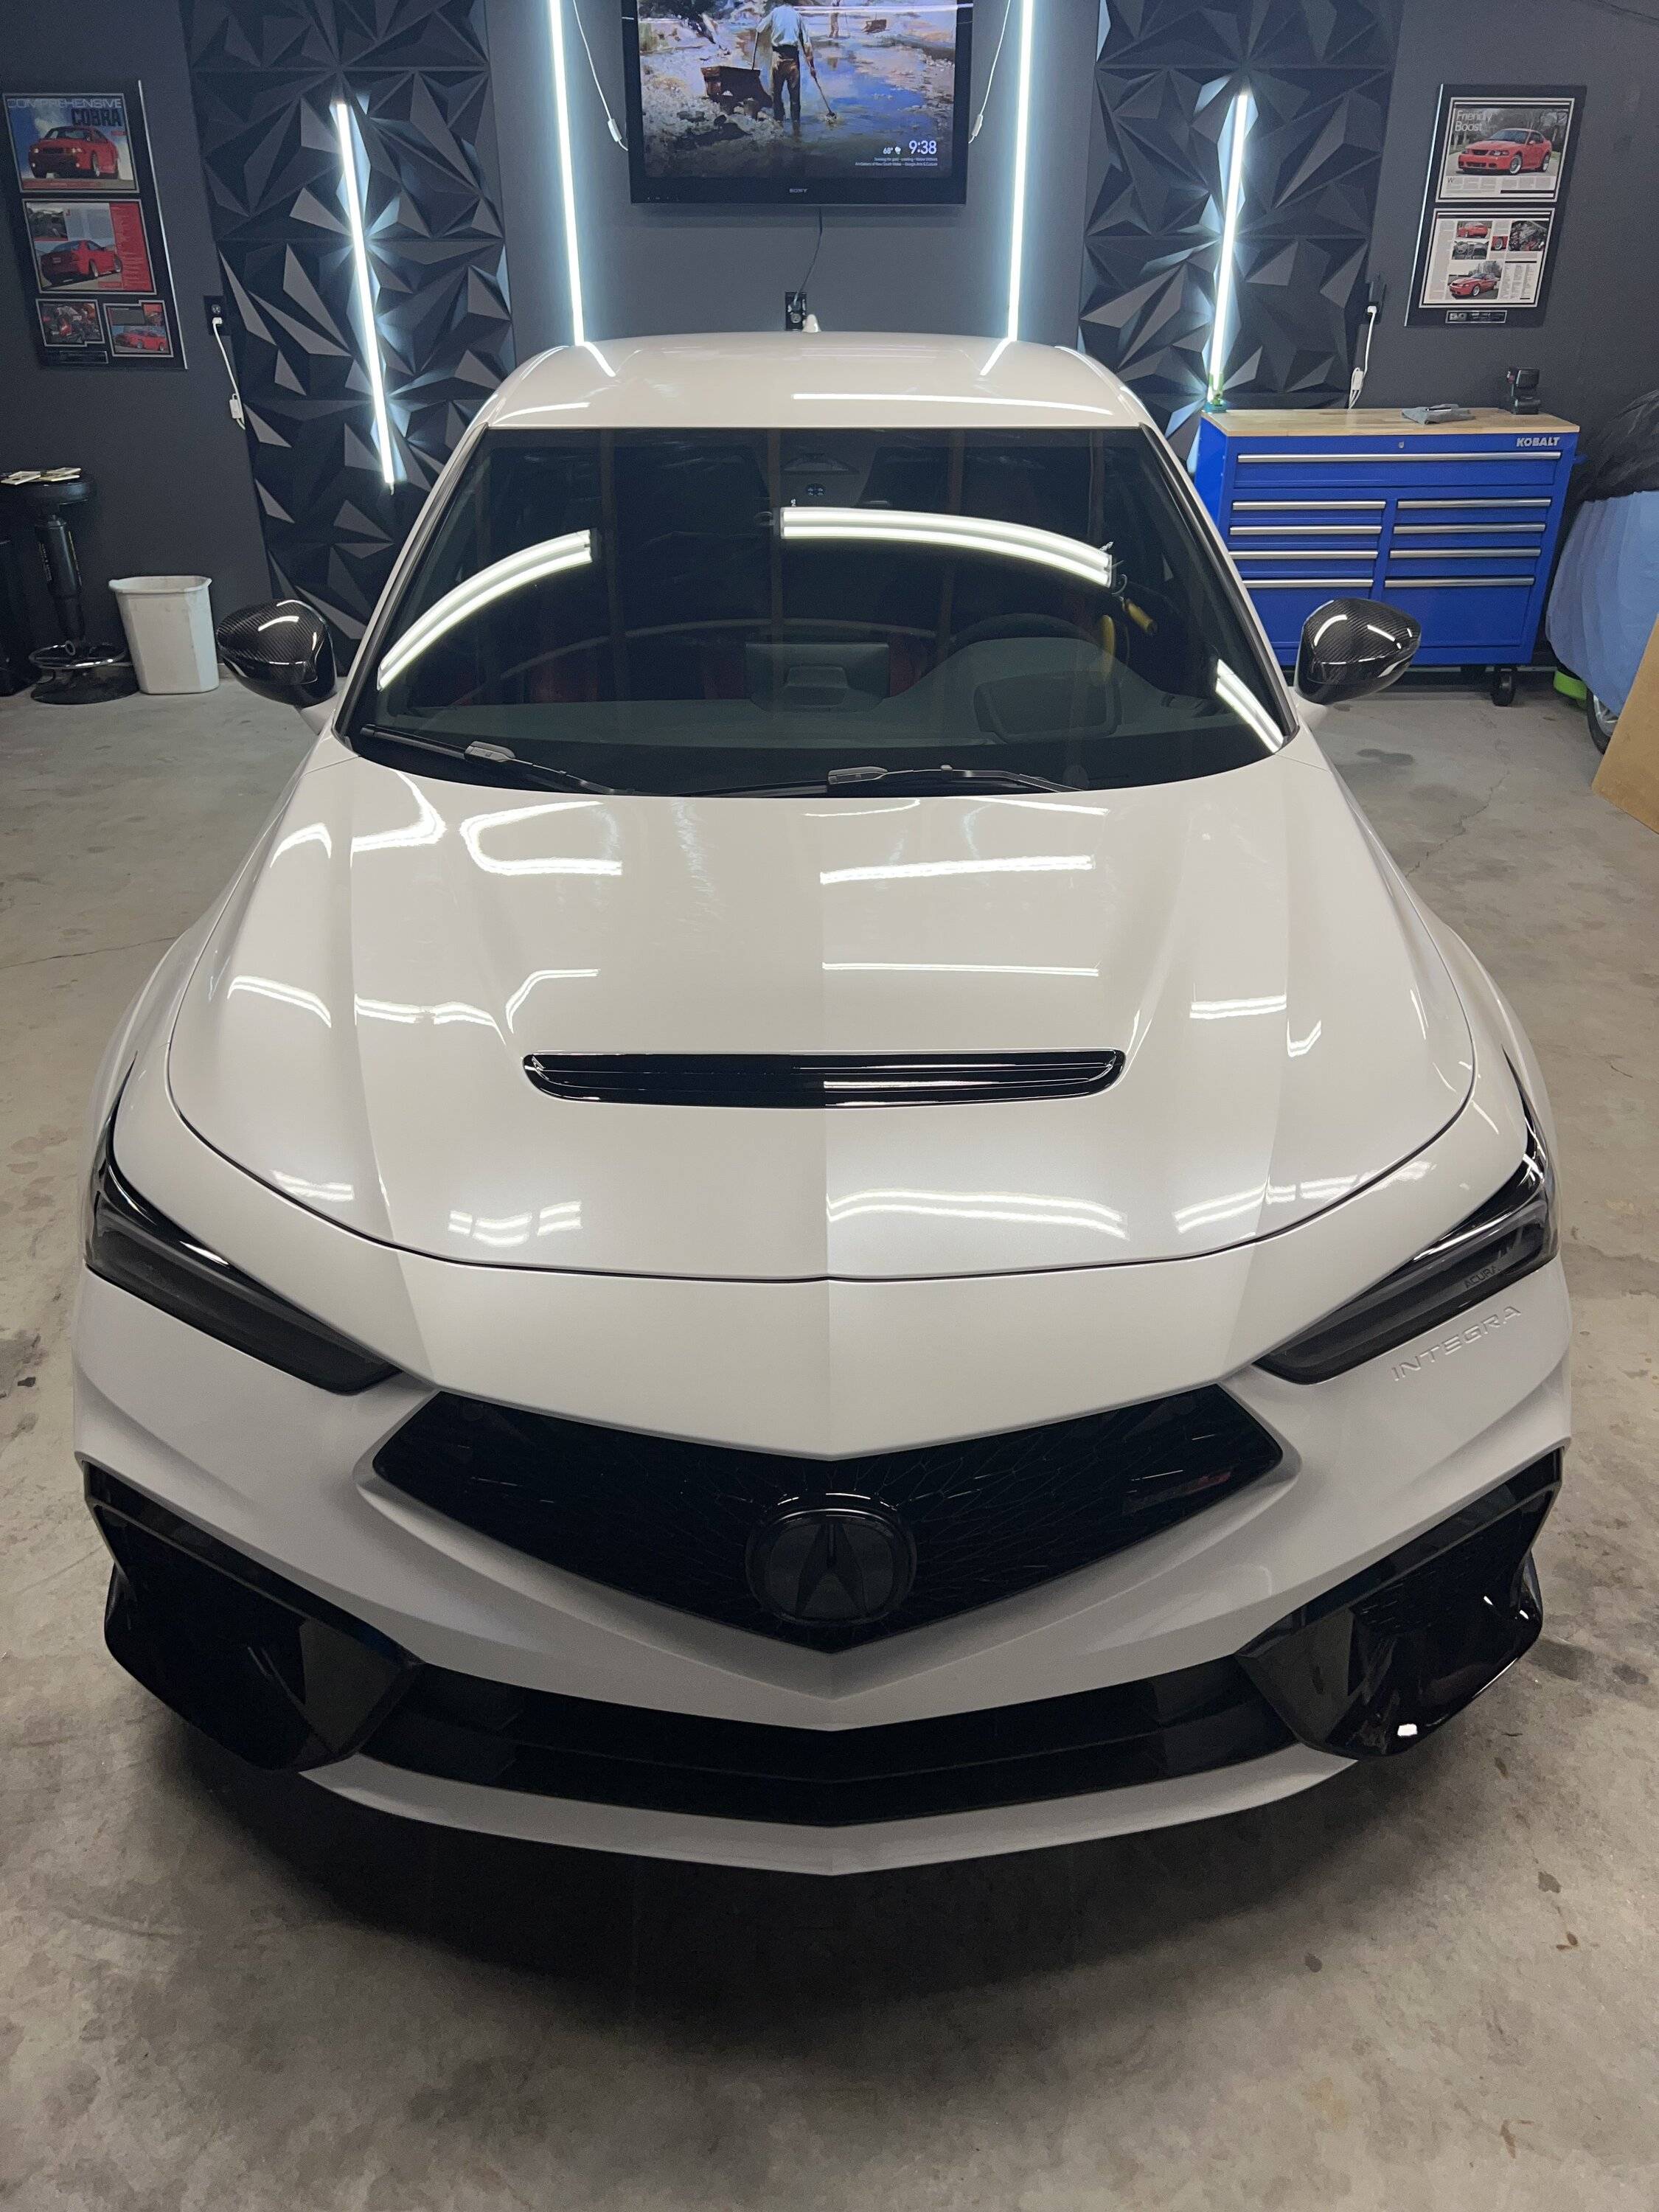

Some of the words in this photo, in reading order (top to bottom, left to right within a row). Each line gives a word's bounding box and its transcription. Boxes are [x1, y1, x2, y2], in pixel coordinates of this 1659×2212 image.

[72, 108, 122, 127] COBRA
[1455, 109, 1492, 122] Friendly
[1455, 121, 1483, 131] Boost
[908, 140, 937, 155] 9:38
[1516, 437, 1560, 447] KOBALT
[1464, 1265, 1500, 1289] ACURA
[1391, 1305, 1522, 1382] INTEGRA
